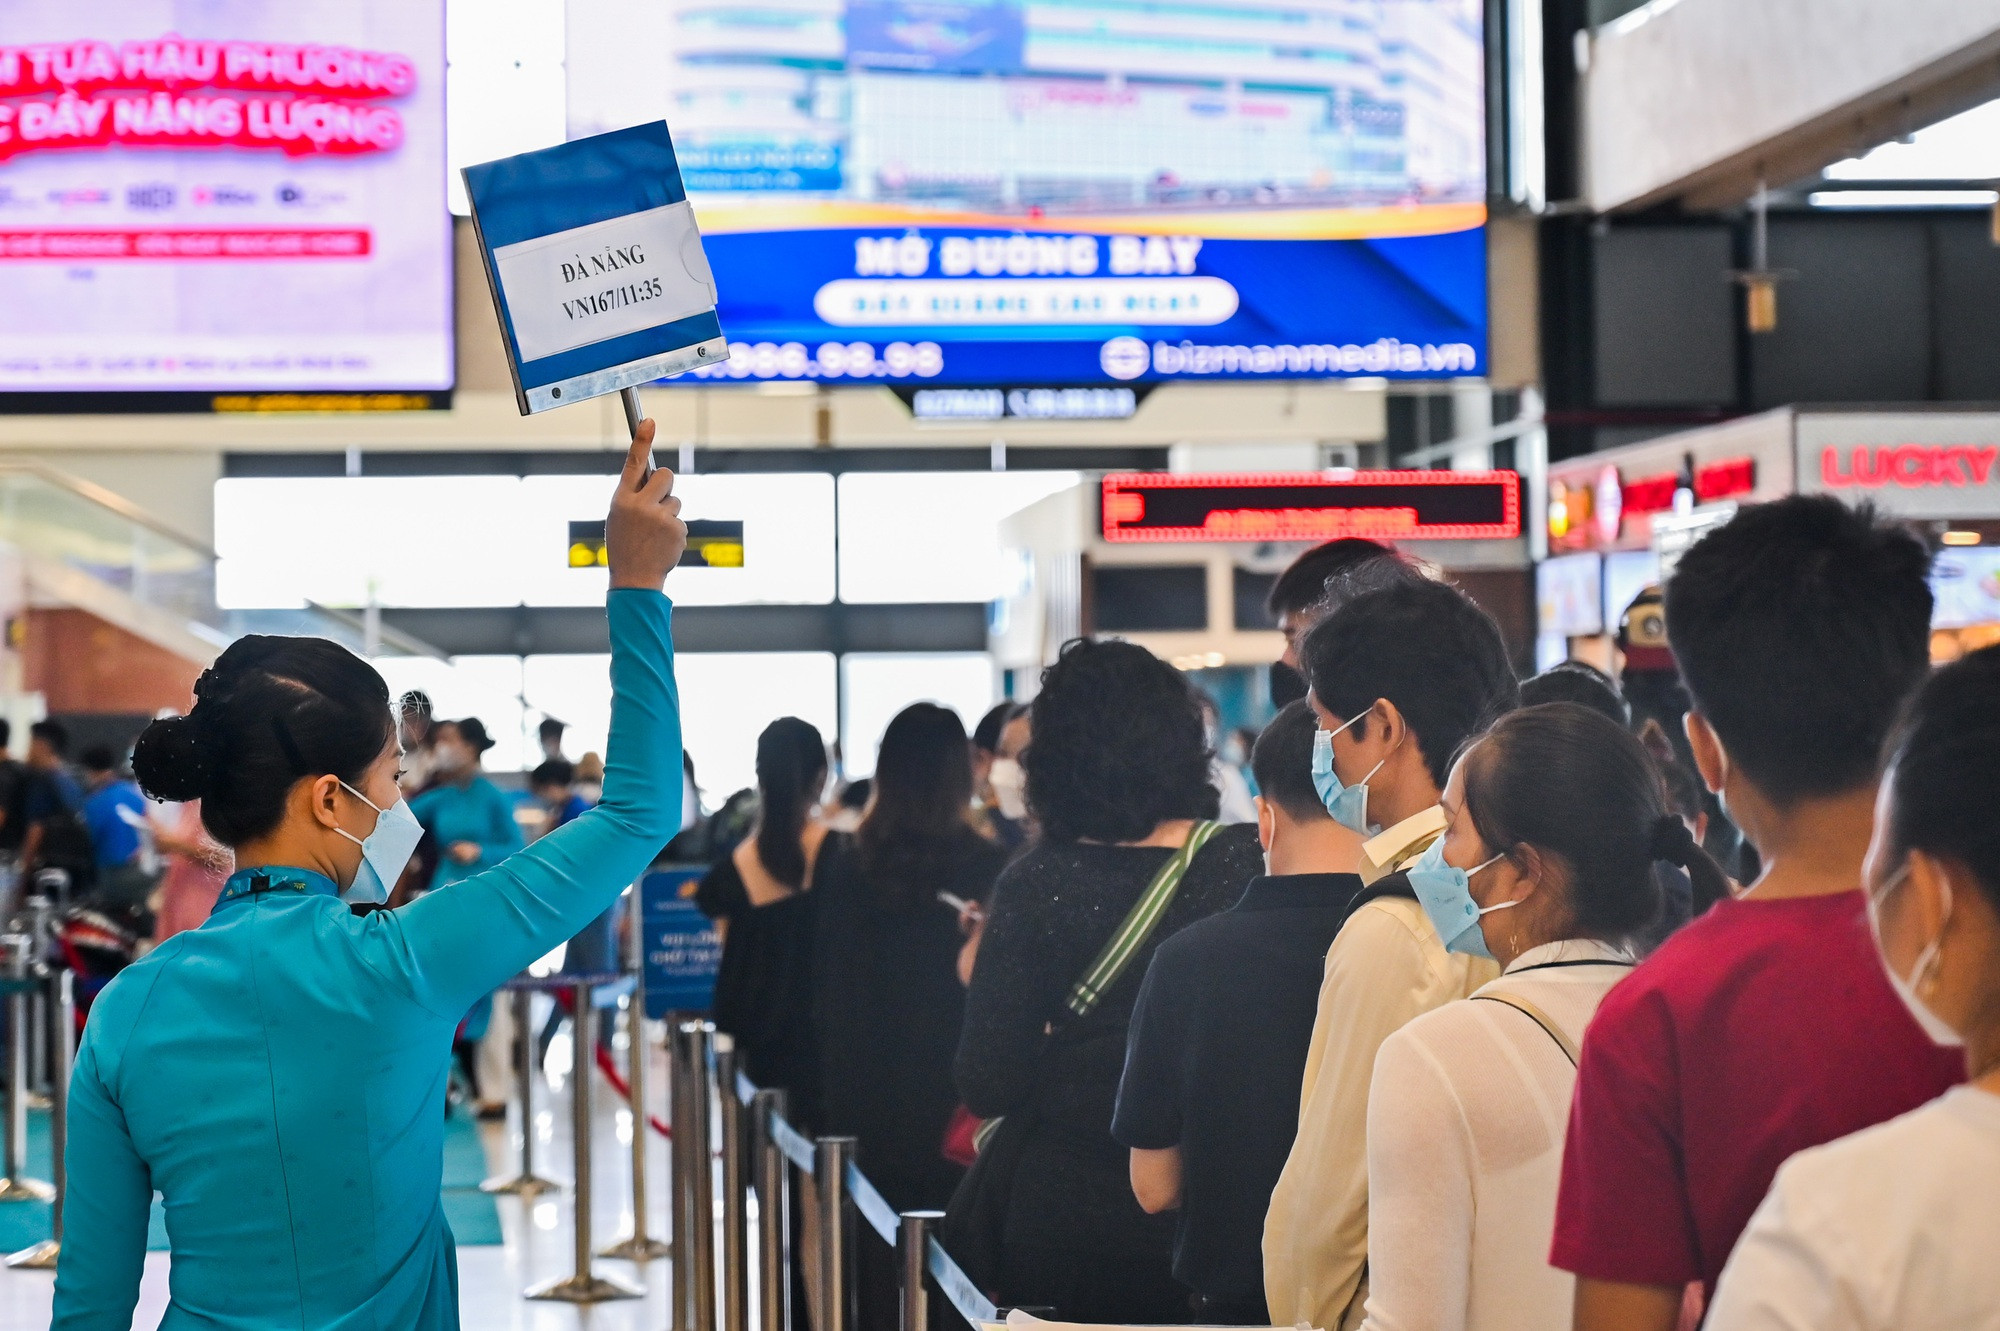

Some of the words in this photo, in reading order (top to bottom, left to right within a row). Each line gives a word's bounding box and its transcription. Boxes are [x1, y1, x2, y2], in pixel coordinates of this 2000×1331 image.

[561, 254, 590, 283] ĐÀ
[590, 244, 645, 276] NẴNG
[1108, 234, 1203, 275] BAY
[562, 277, 663, 321] VN167/11:35
[1153, 338, 1476, 374] bizmanmedia.vn
[1821, 443, 1998, 489] LUCKY
